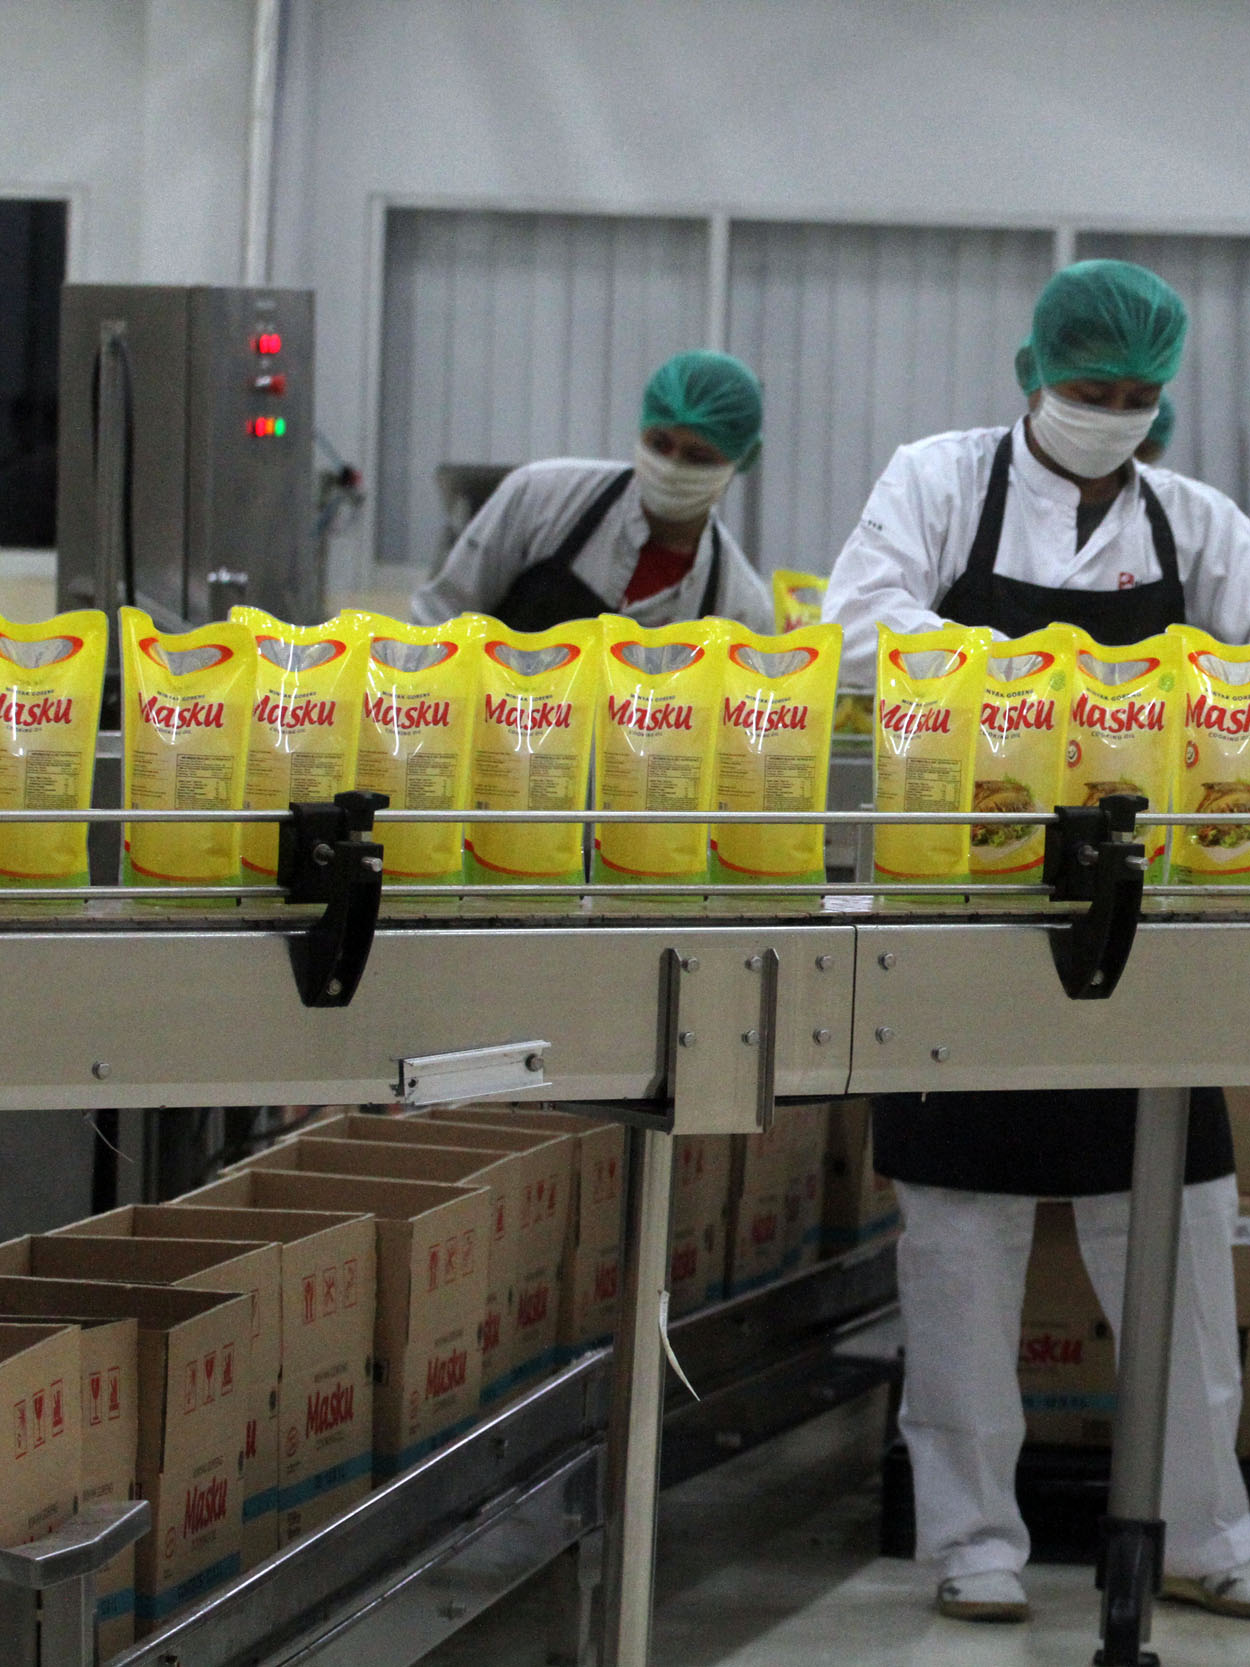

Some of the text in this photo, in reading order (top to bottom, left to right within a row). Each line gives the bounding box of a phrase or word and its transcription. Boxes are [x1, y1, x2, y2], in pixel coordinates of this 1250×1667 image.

[138, 690, 224, 729] Masku
[364, 690, 450, 729] Masku
[485, 693, 573, 731] Masku
[986, 688, 1004, 698] NYAK
[608, 694, 693, 731] Masku
[723, 696, 808, 732] Masku
[880, 698, 951, 735] Masku
[980, 698, 1055, 733] asku
[425, 1348, 467, 1400] Masku
[306, 1382, 354, 1439] Masku
[184, 1476, 227, 1539] Masku
